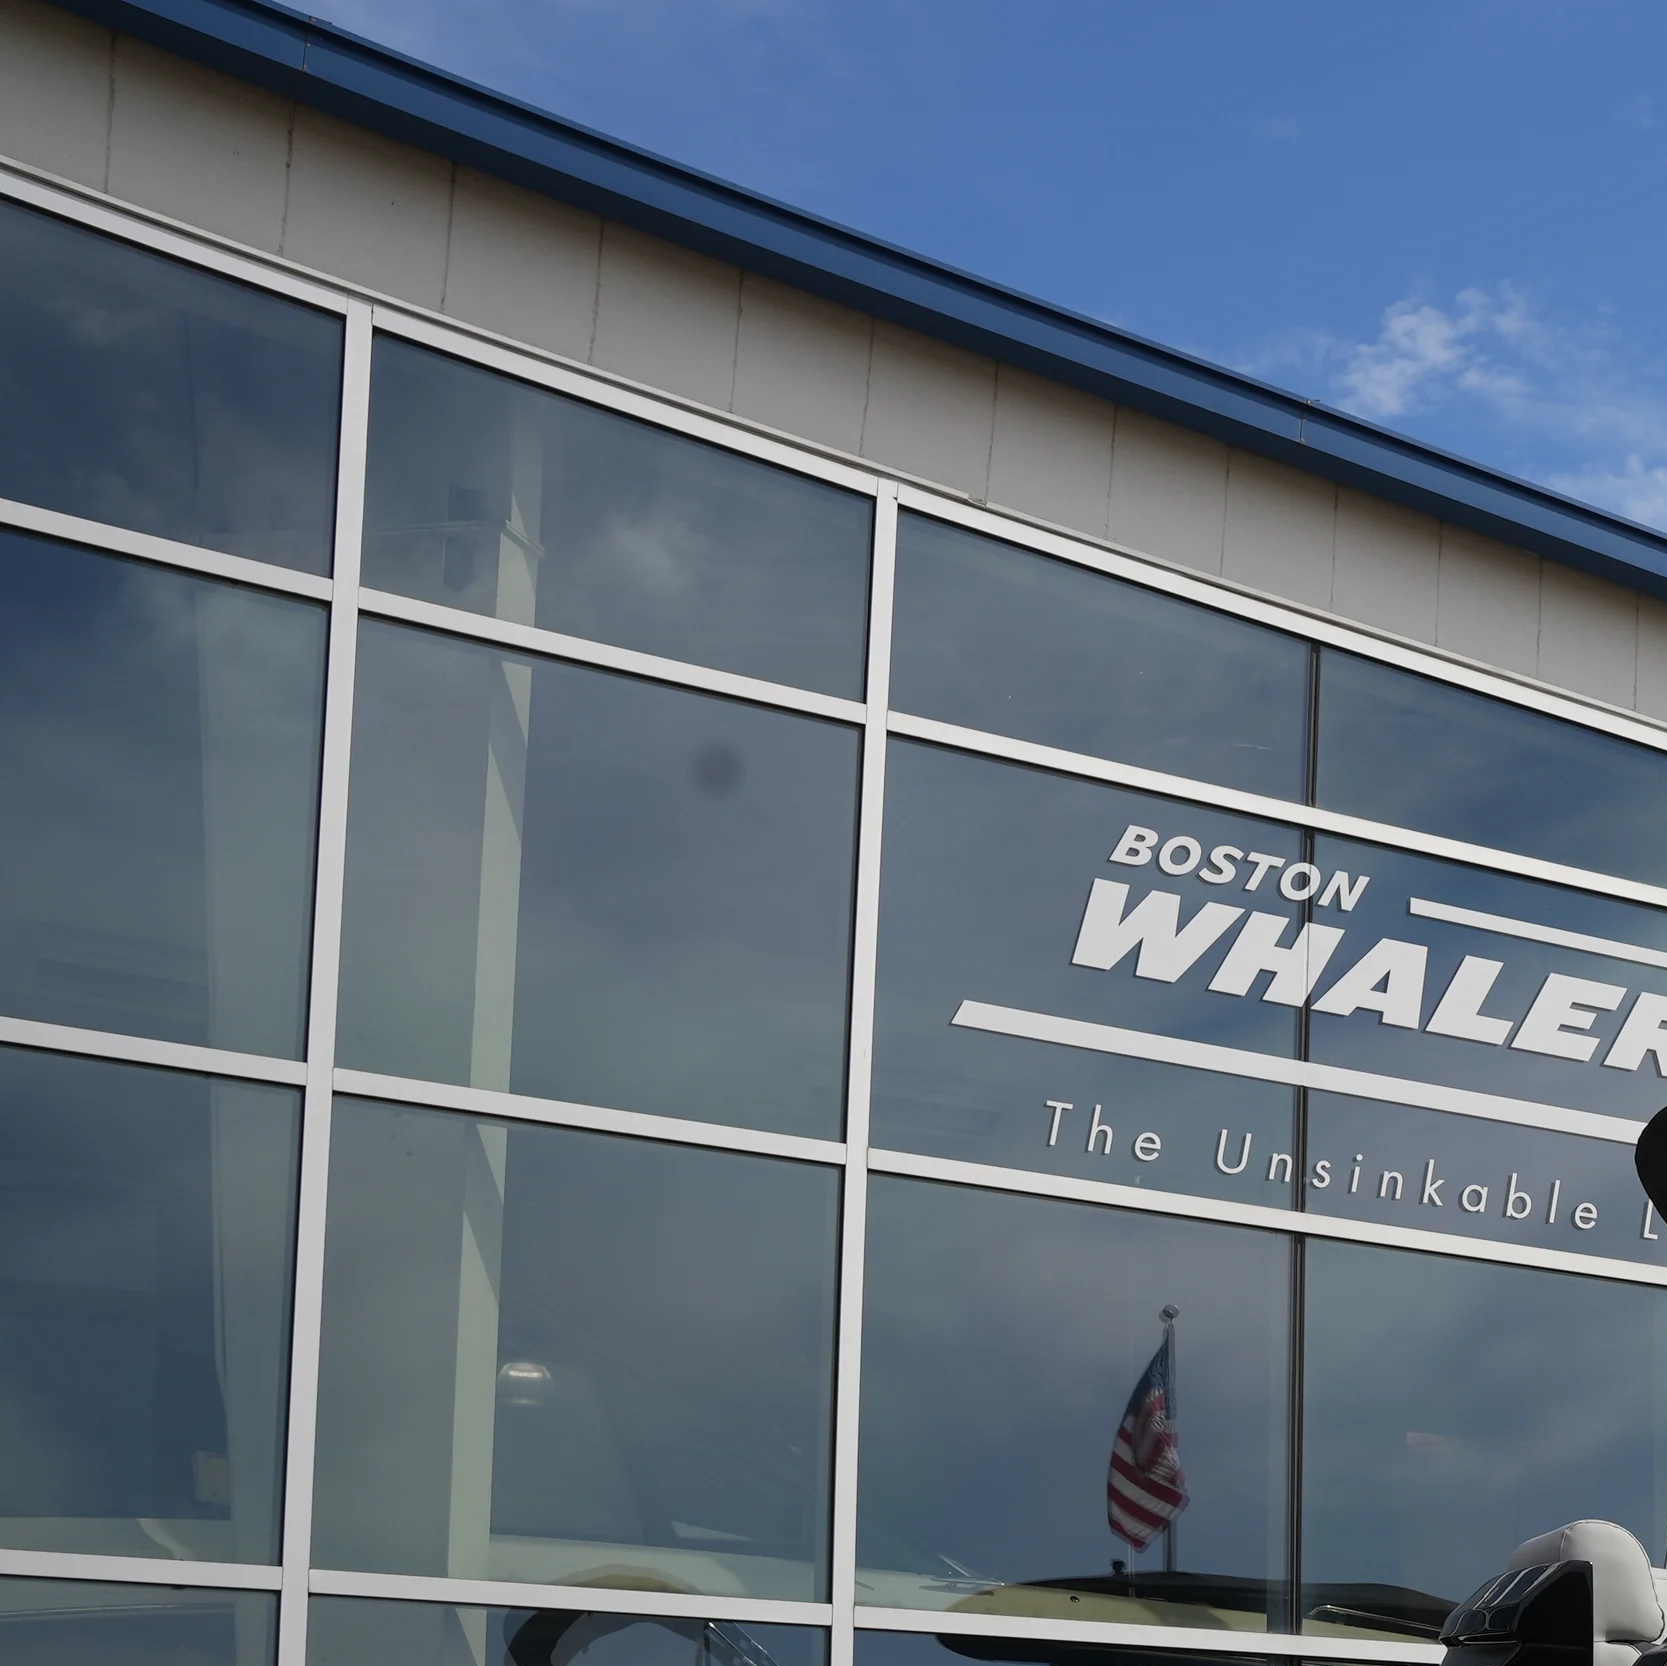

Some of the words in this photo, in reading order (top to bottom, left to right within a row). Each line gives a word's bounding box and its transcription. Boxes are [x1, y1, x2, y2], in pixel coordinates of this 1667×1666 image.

[1107, 823, 1370, 913] BOSTON
[1043, 1099, 1161, 1163] The
[1215, 1127, 1598, 1230] Unsinkable
